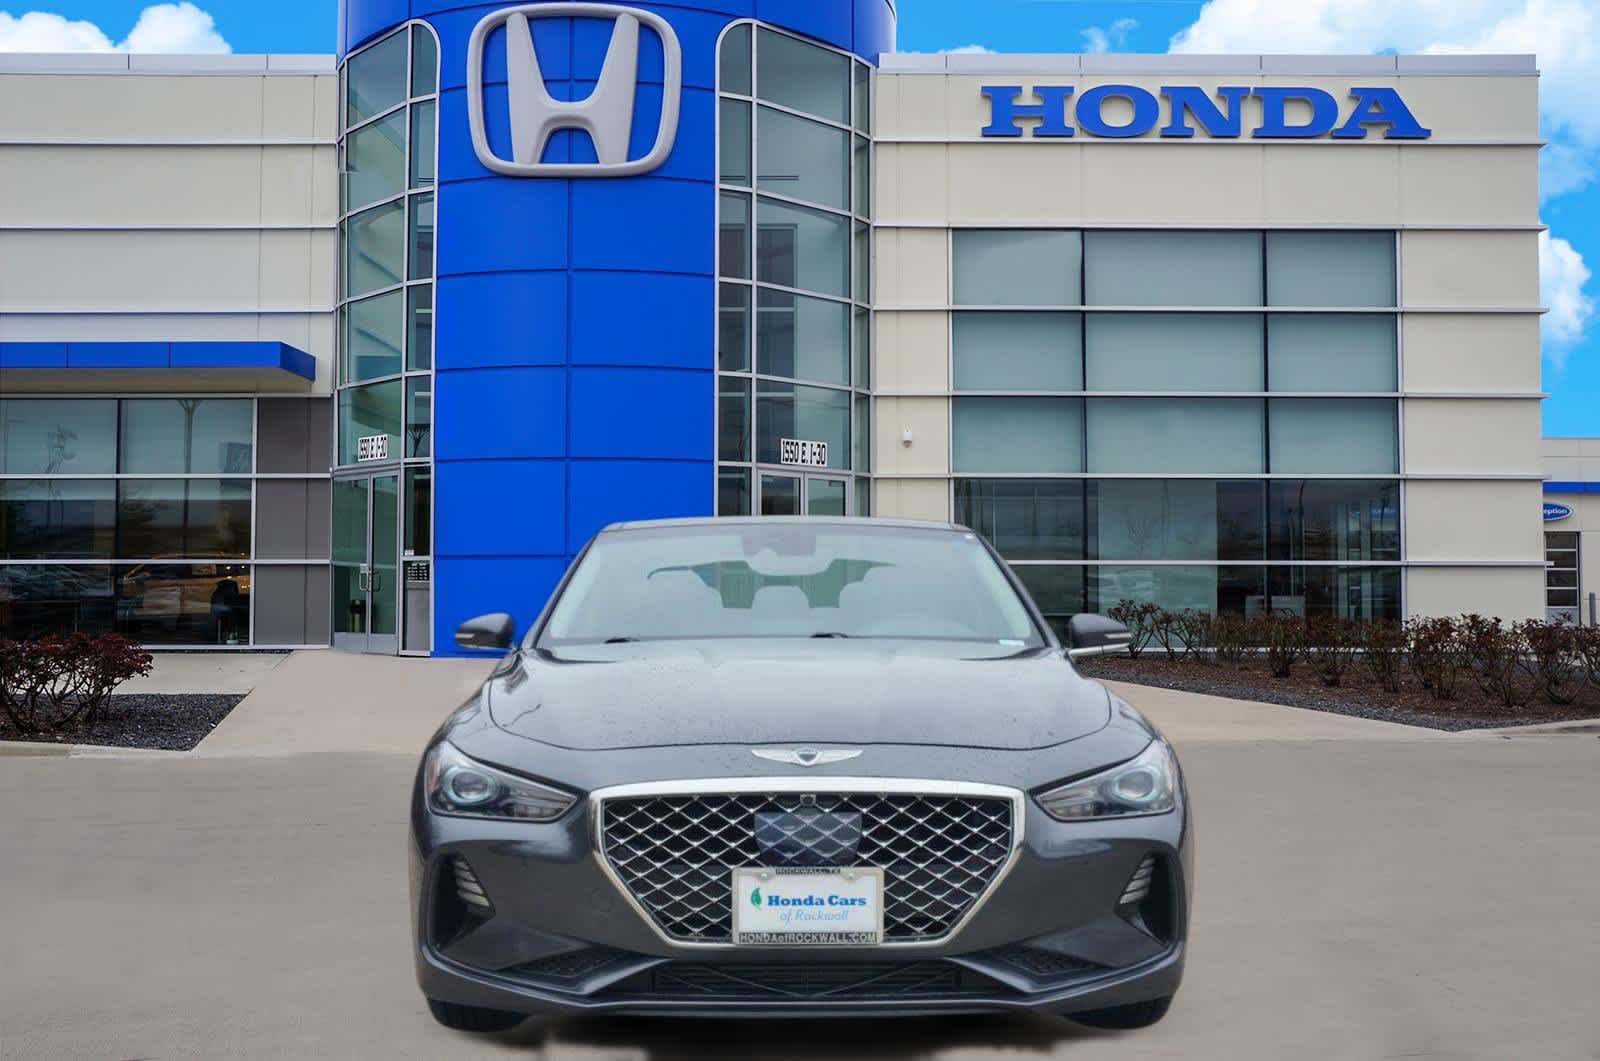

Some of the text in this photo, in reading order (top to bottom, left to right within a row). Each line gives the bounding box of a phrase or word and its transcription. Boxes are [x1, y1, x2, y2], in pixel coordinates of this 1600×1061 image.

[981, 85, 1432, 138] HONDA
[782, 440, 800, 463] 1550
[810, 443, 826, 465] I-30
[767, 895, 867, 907] Honda Cars
[779, 909, 849, 927] of Rockwall
